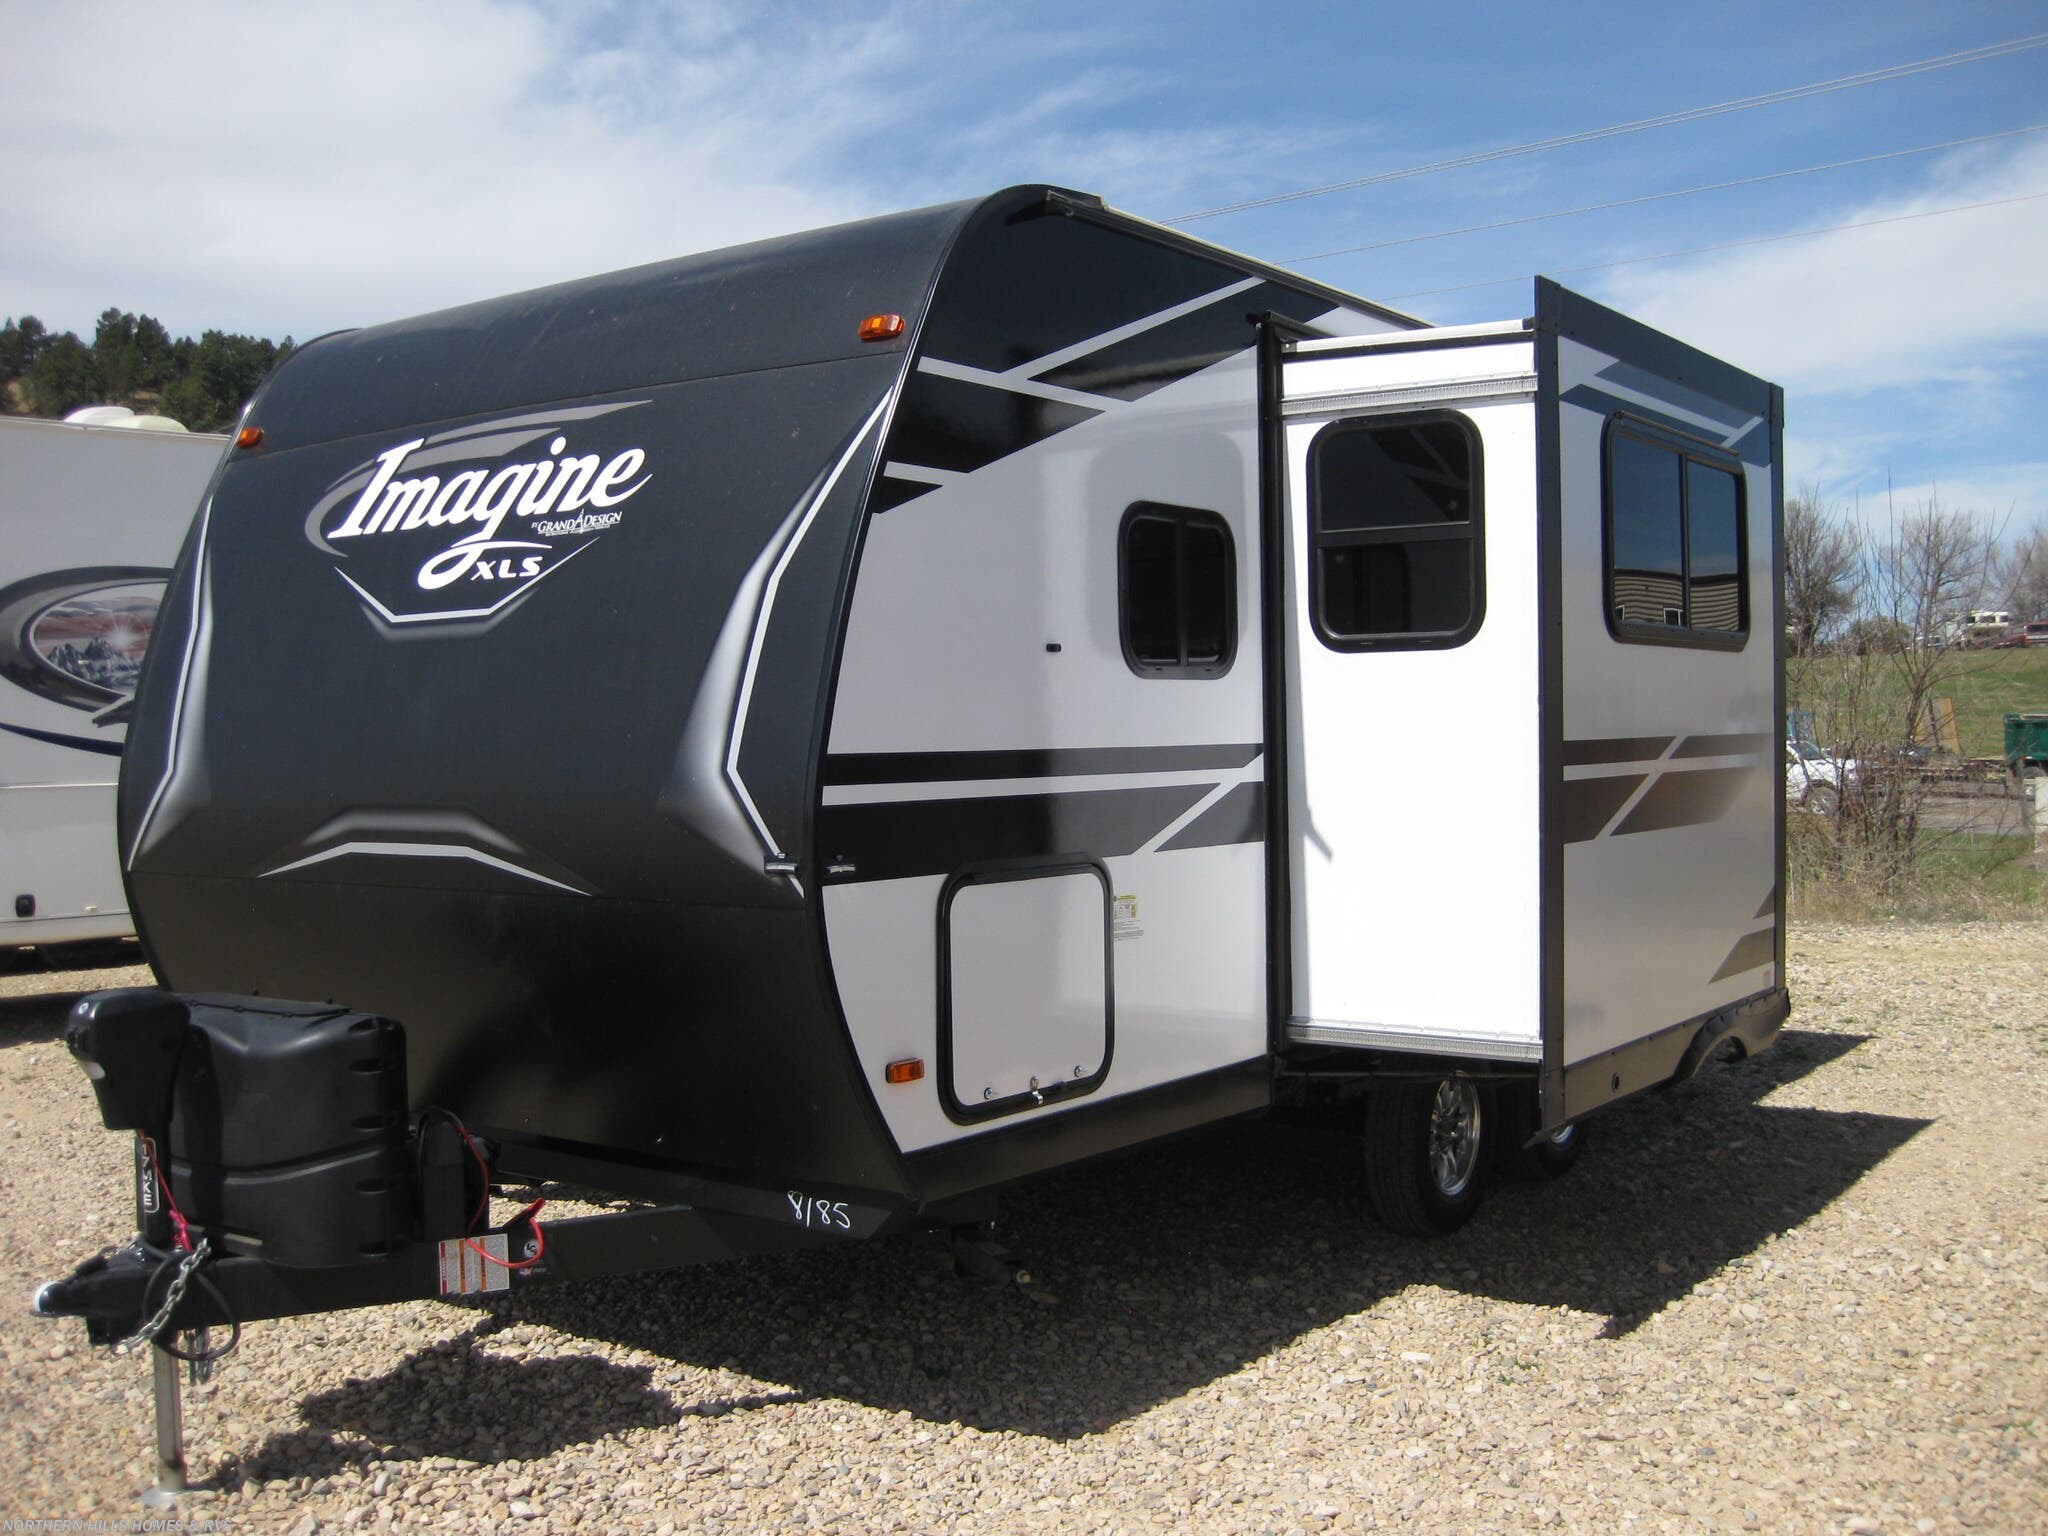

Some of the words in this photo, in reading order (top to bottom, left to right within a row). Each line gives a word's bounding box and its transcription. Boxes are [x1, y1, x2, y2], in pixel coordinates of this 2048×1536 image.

[327, 436, 653, 590] Imagine
[537, 520, 575, 532] GRAND
[584, 511, 622, 526] DESIGN
[470, 556, 543, 581] XLS
[787, 1190, 851, 1228] 8185
